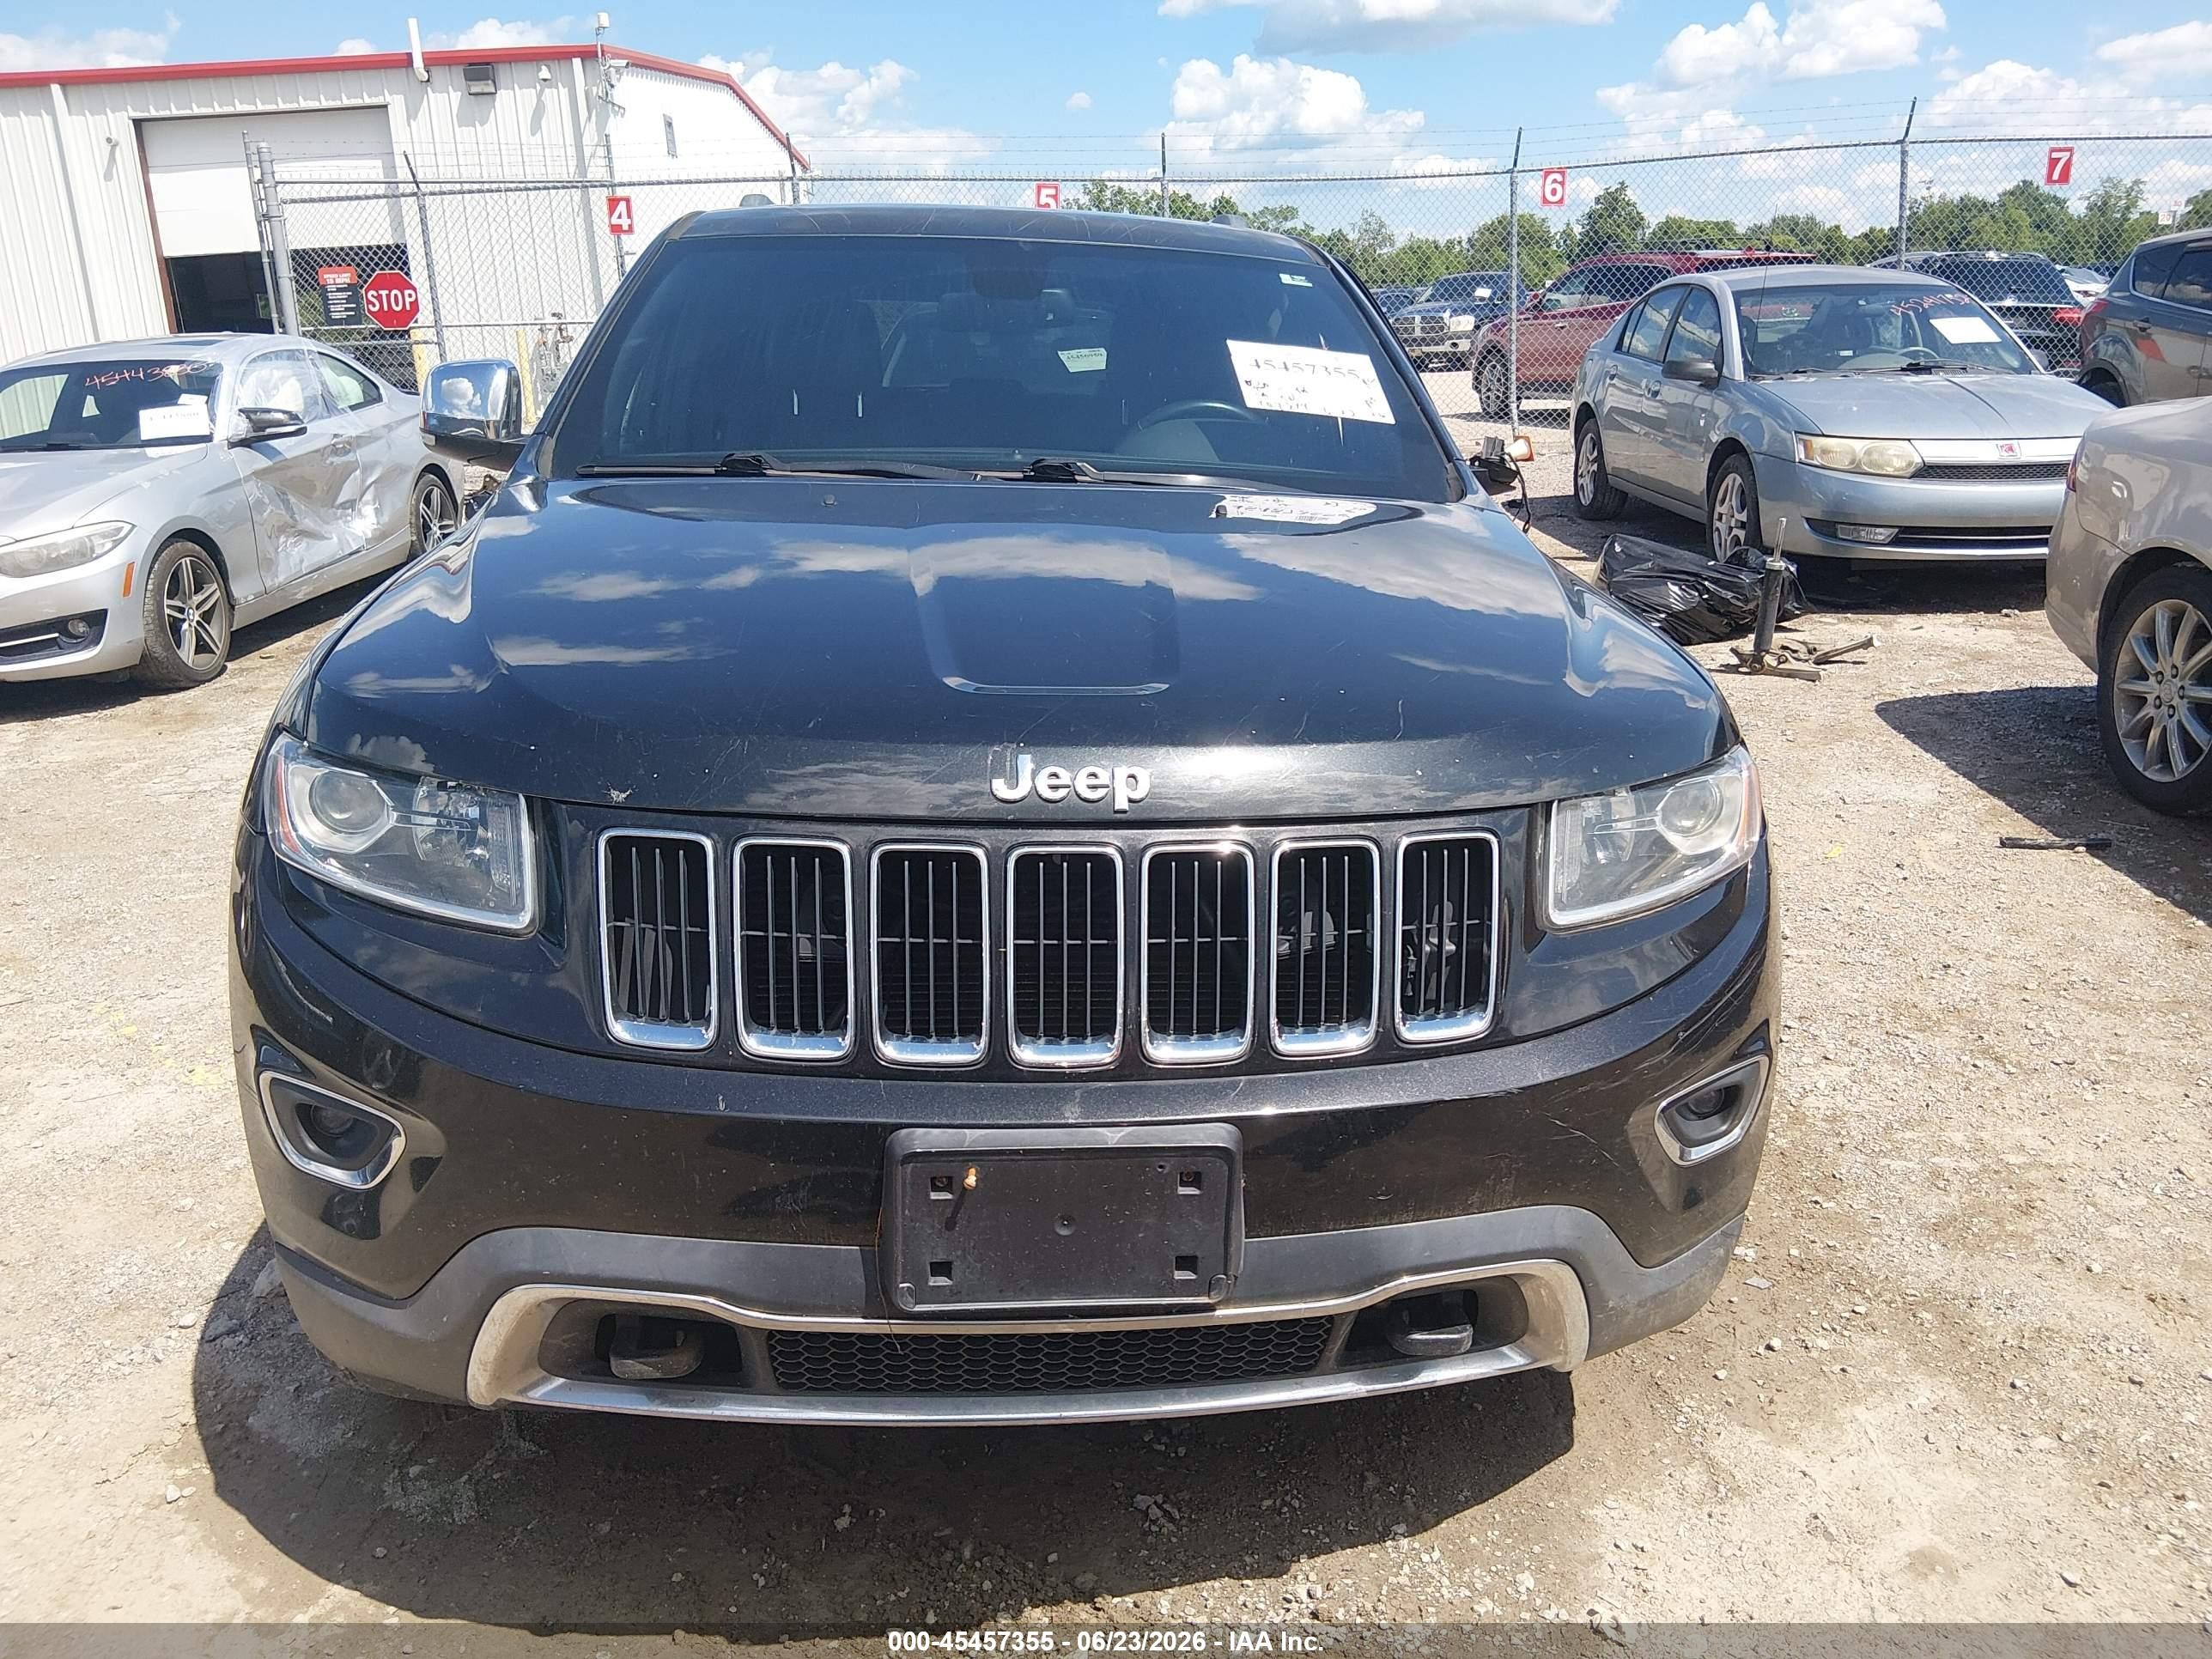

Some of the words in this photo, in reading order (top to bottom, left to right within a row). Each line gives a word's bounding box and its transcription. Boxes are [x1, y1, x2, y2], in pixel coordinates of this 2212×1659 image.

[2051, 151, 2071, 180] 7
[1039, 188, 1057, 210] 5
[1544, 173, 1564, 203] 6
[611, 200, 632, 231] 4
[367, 289, 416, 312] STOP
[990, 753, 1152, 812] Jeep
